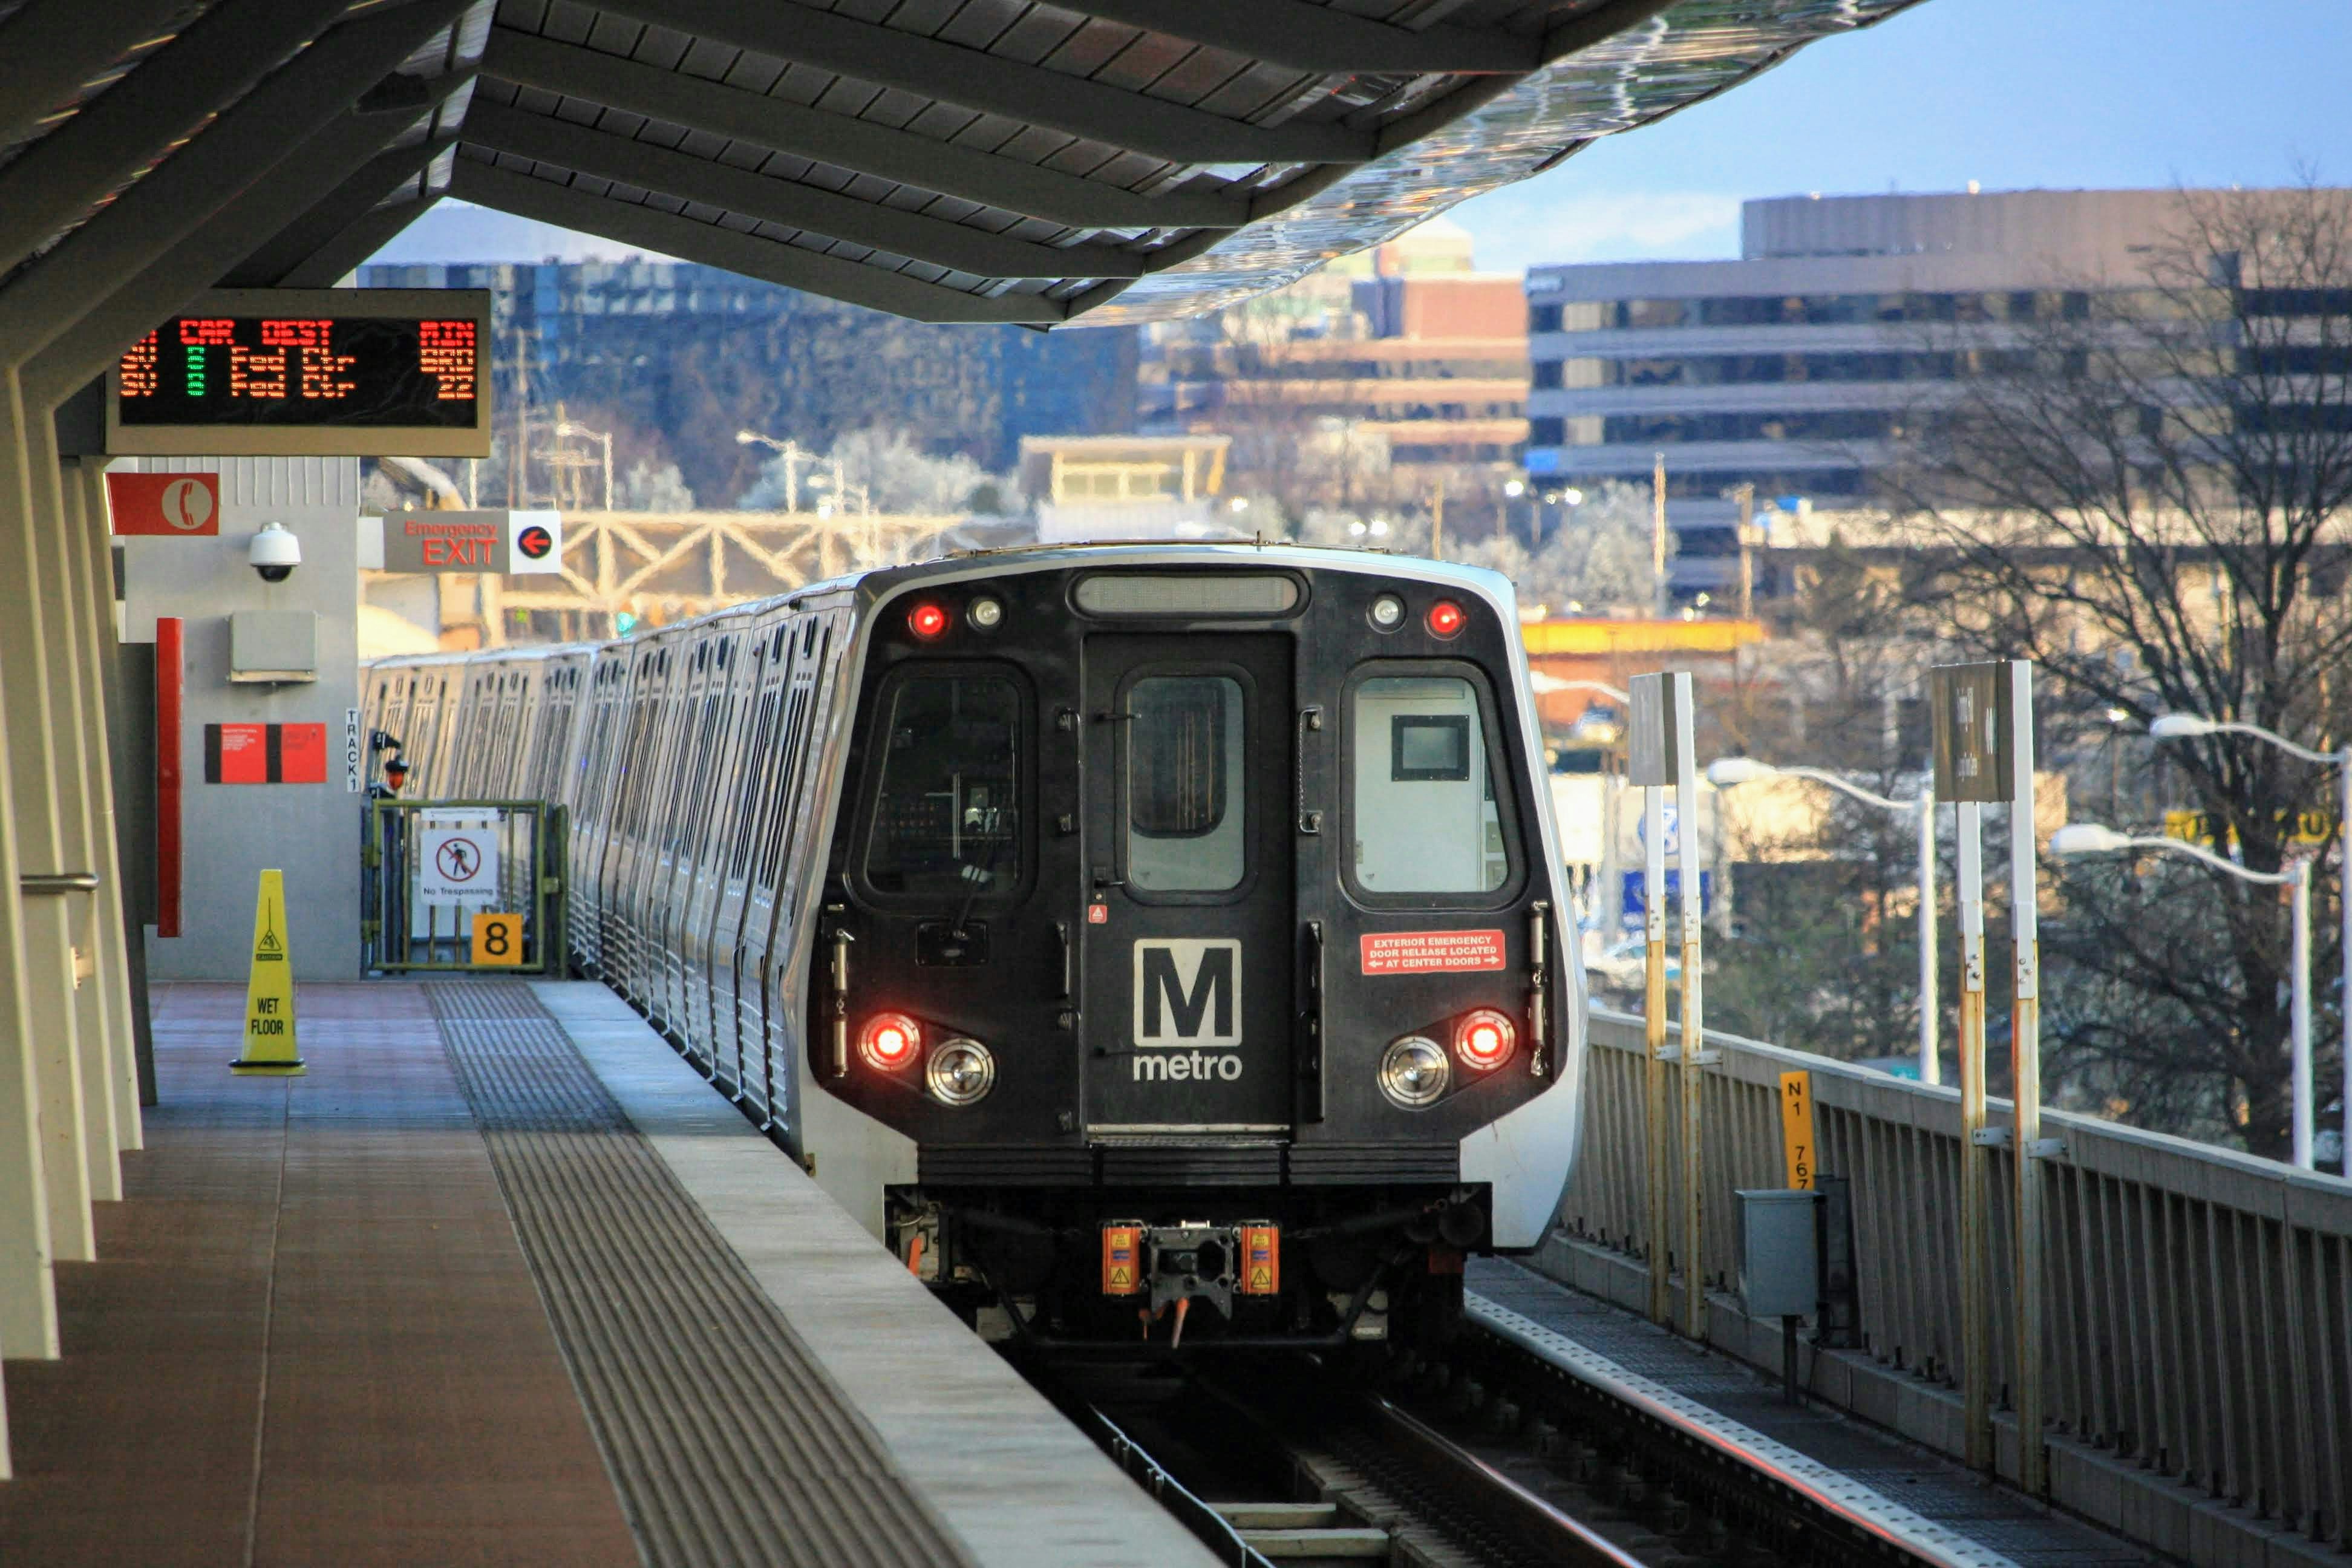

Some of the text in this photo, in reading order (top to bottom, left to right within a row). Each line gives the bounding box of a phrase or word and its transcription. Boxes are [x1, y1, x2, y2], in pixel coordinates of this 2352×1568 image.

[180, 319, 235, 345] CAR
[261, 320, 333, 346] DEST
[419, 321, 474, 346] MIN
[302, 347, 356, 371] Ctr
[302, 373, 356, 398] Ctr
[405, 520, 497, 537] Emergency
[423, 538, 498, 566] EXIT
[348, 710, 356, 776] TRACK
[440, 887, 494, 897] Trespassing
[485, 922, 509, 956] 8
[1374, 936, 1492, 948] EXTERIOR EMERGENCY
[1370, 947, 1497, 958] DOOR RELEASE LOCATED
[1402, 958, 1442, 967] CENTER
[1445, 957, 1481, 965] DOORS
[1143, 947, 1233, 1037] M
[256, 998, 279, 1014] WET
[251, 1019, 284, 1035] FLOOR
[1132, 1050, 1243, 1081] metro
